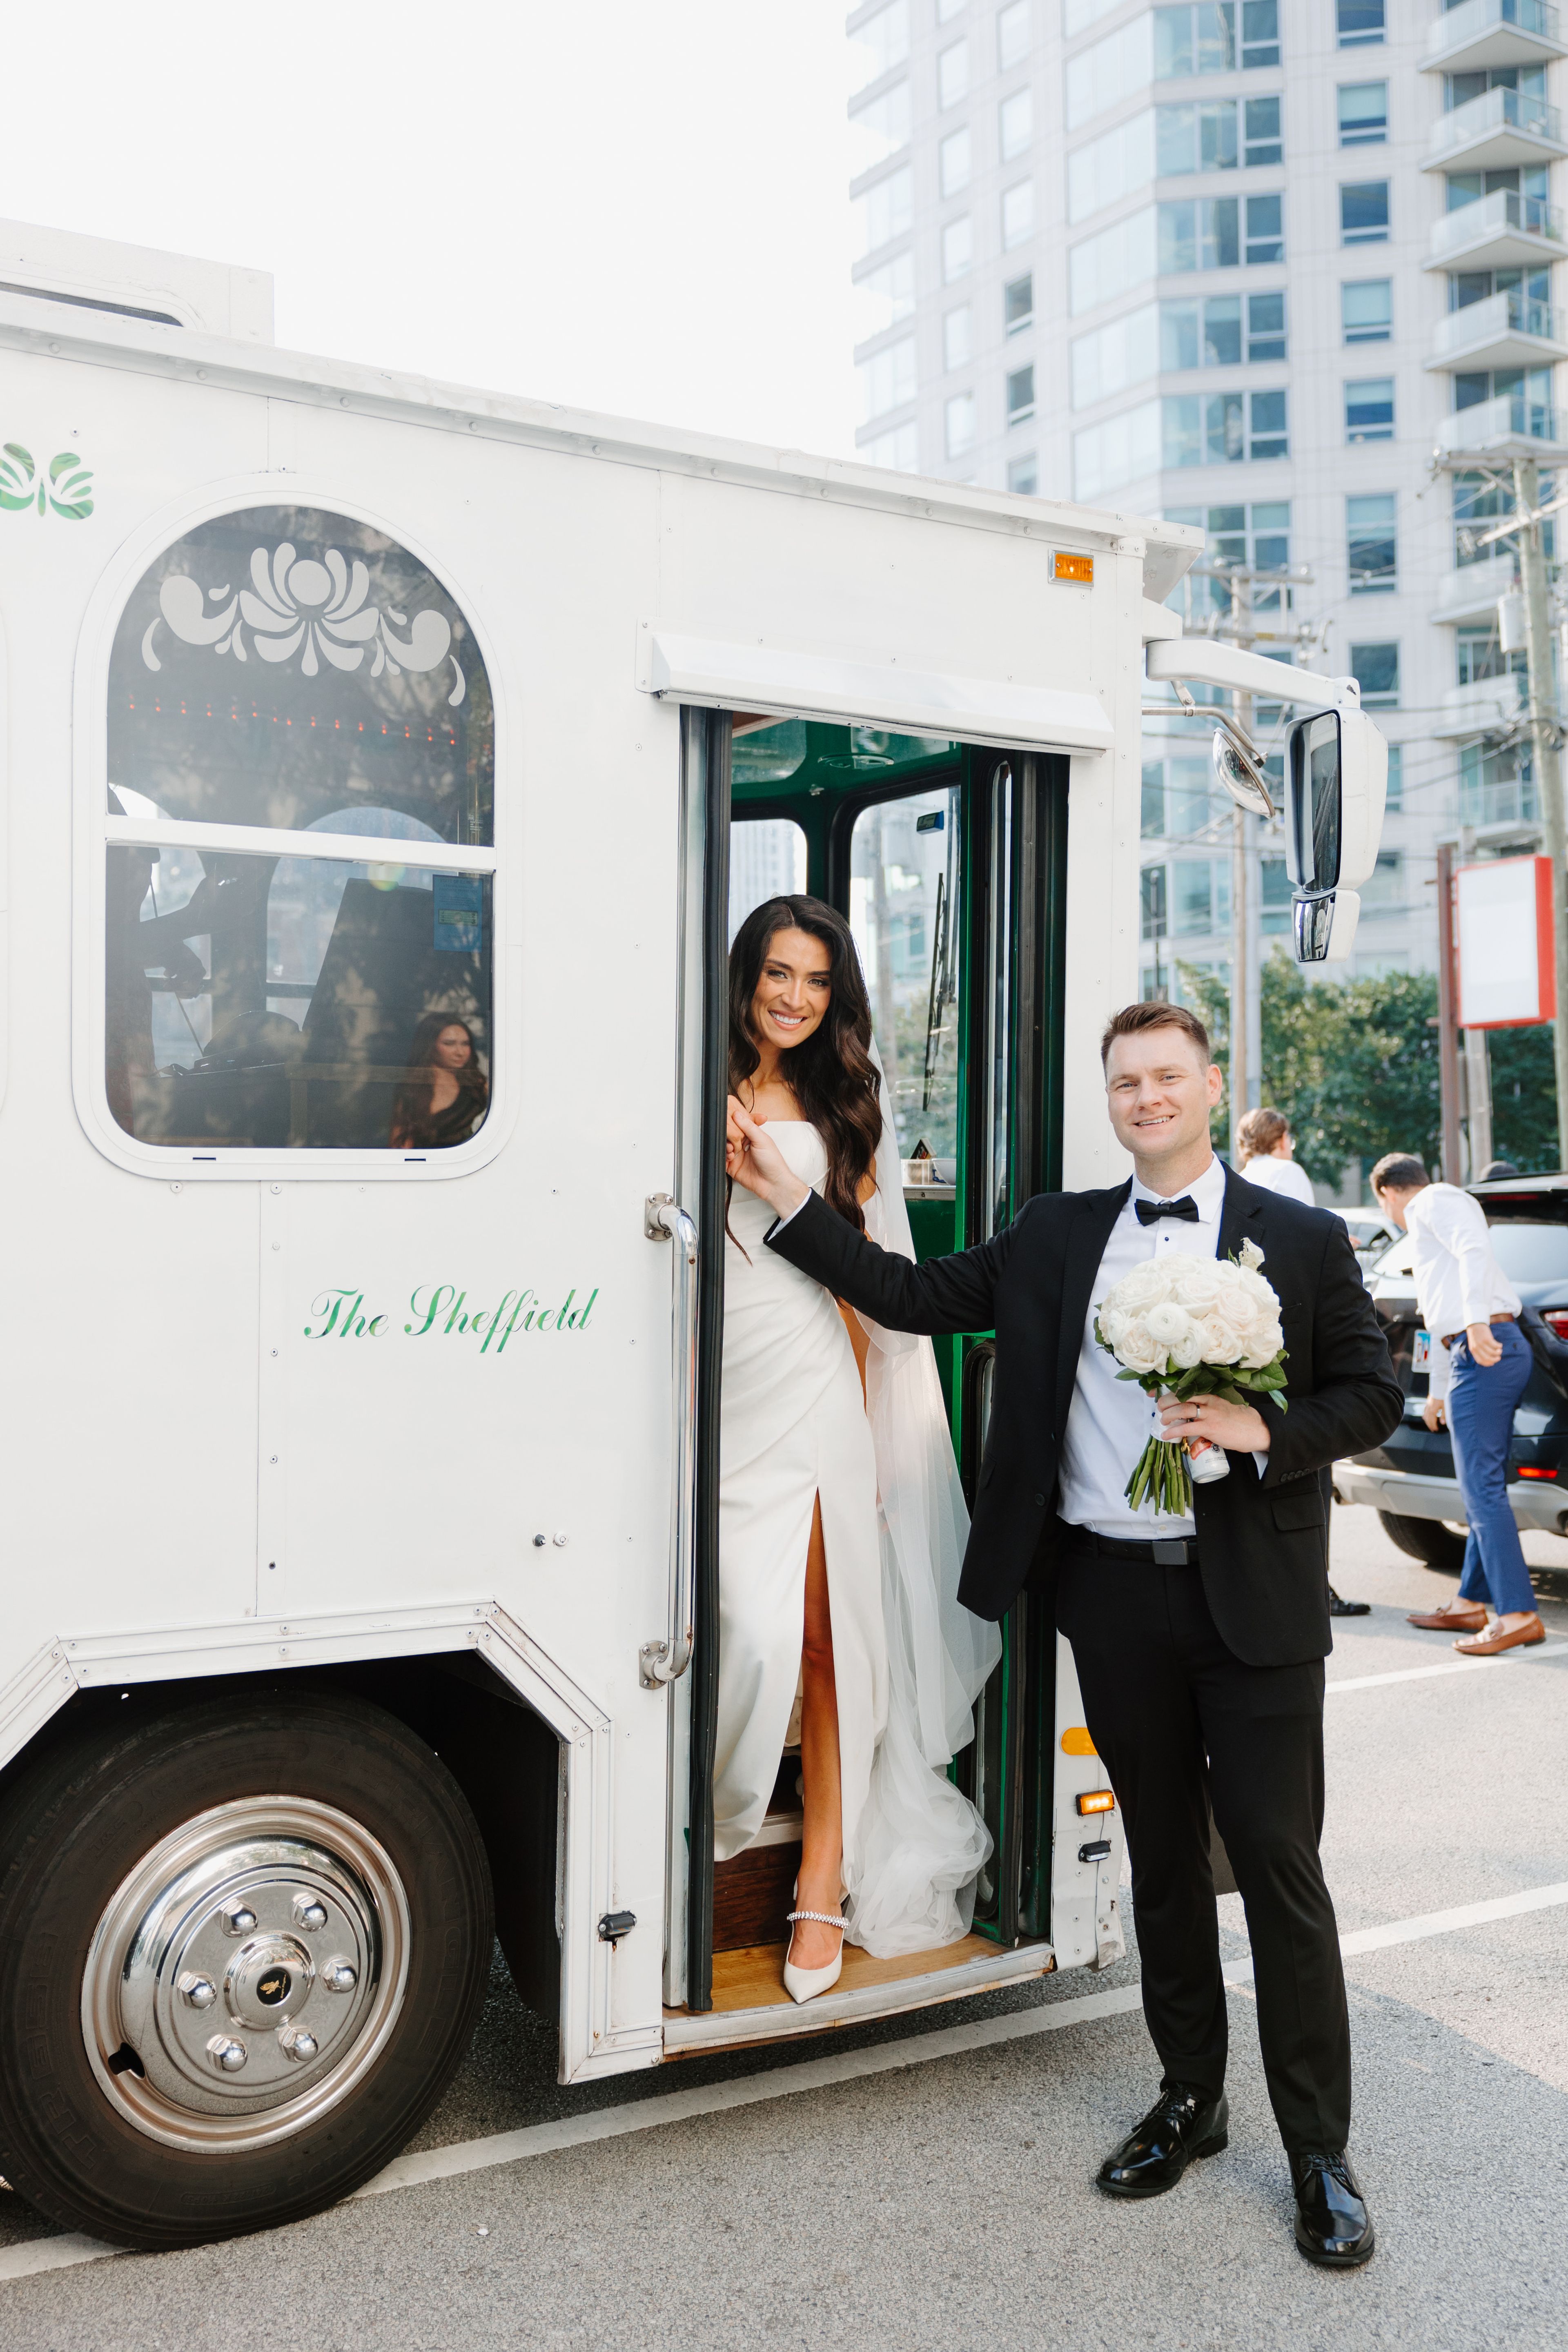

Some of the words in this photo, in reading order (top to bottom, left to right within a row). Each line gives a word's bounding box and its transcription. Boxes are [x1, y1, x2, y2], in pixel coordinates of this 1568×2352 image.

[304, 1287, 389, 1339] The
[404, 1285, 599, 1353] Sheffield
[354, 1757, 463, 2058] TRIANGLE
